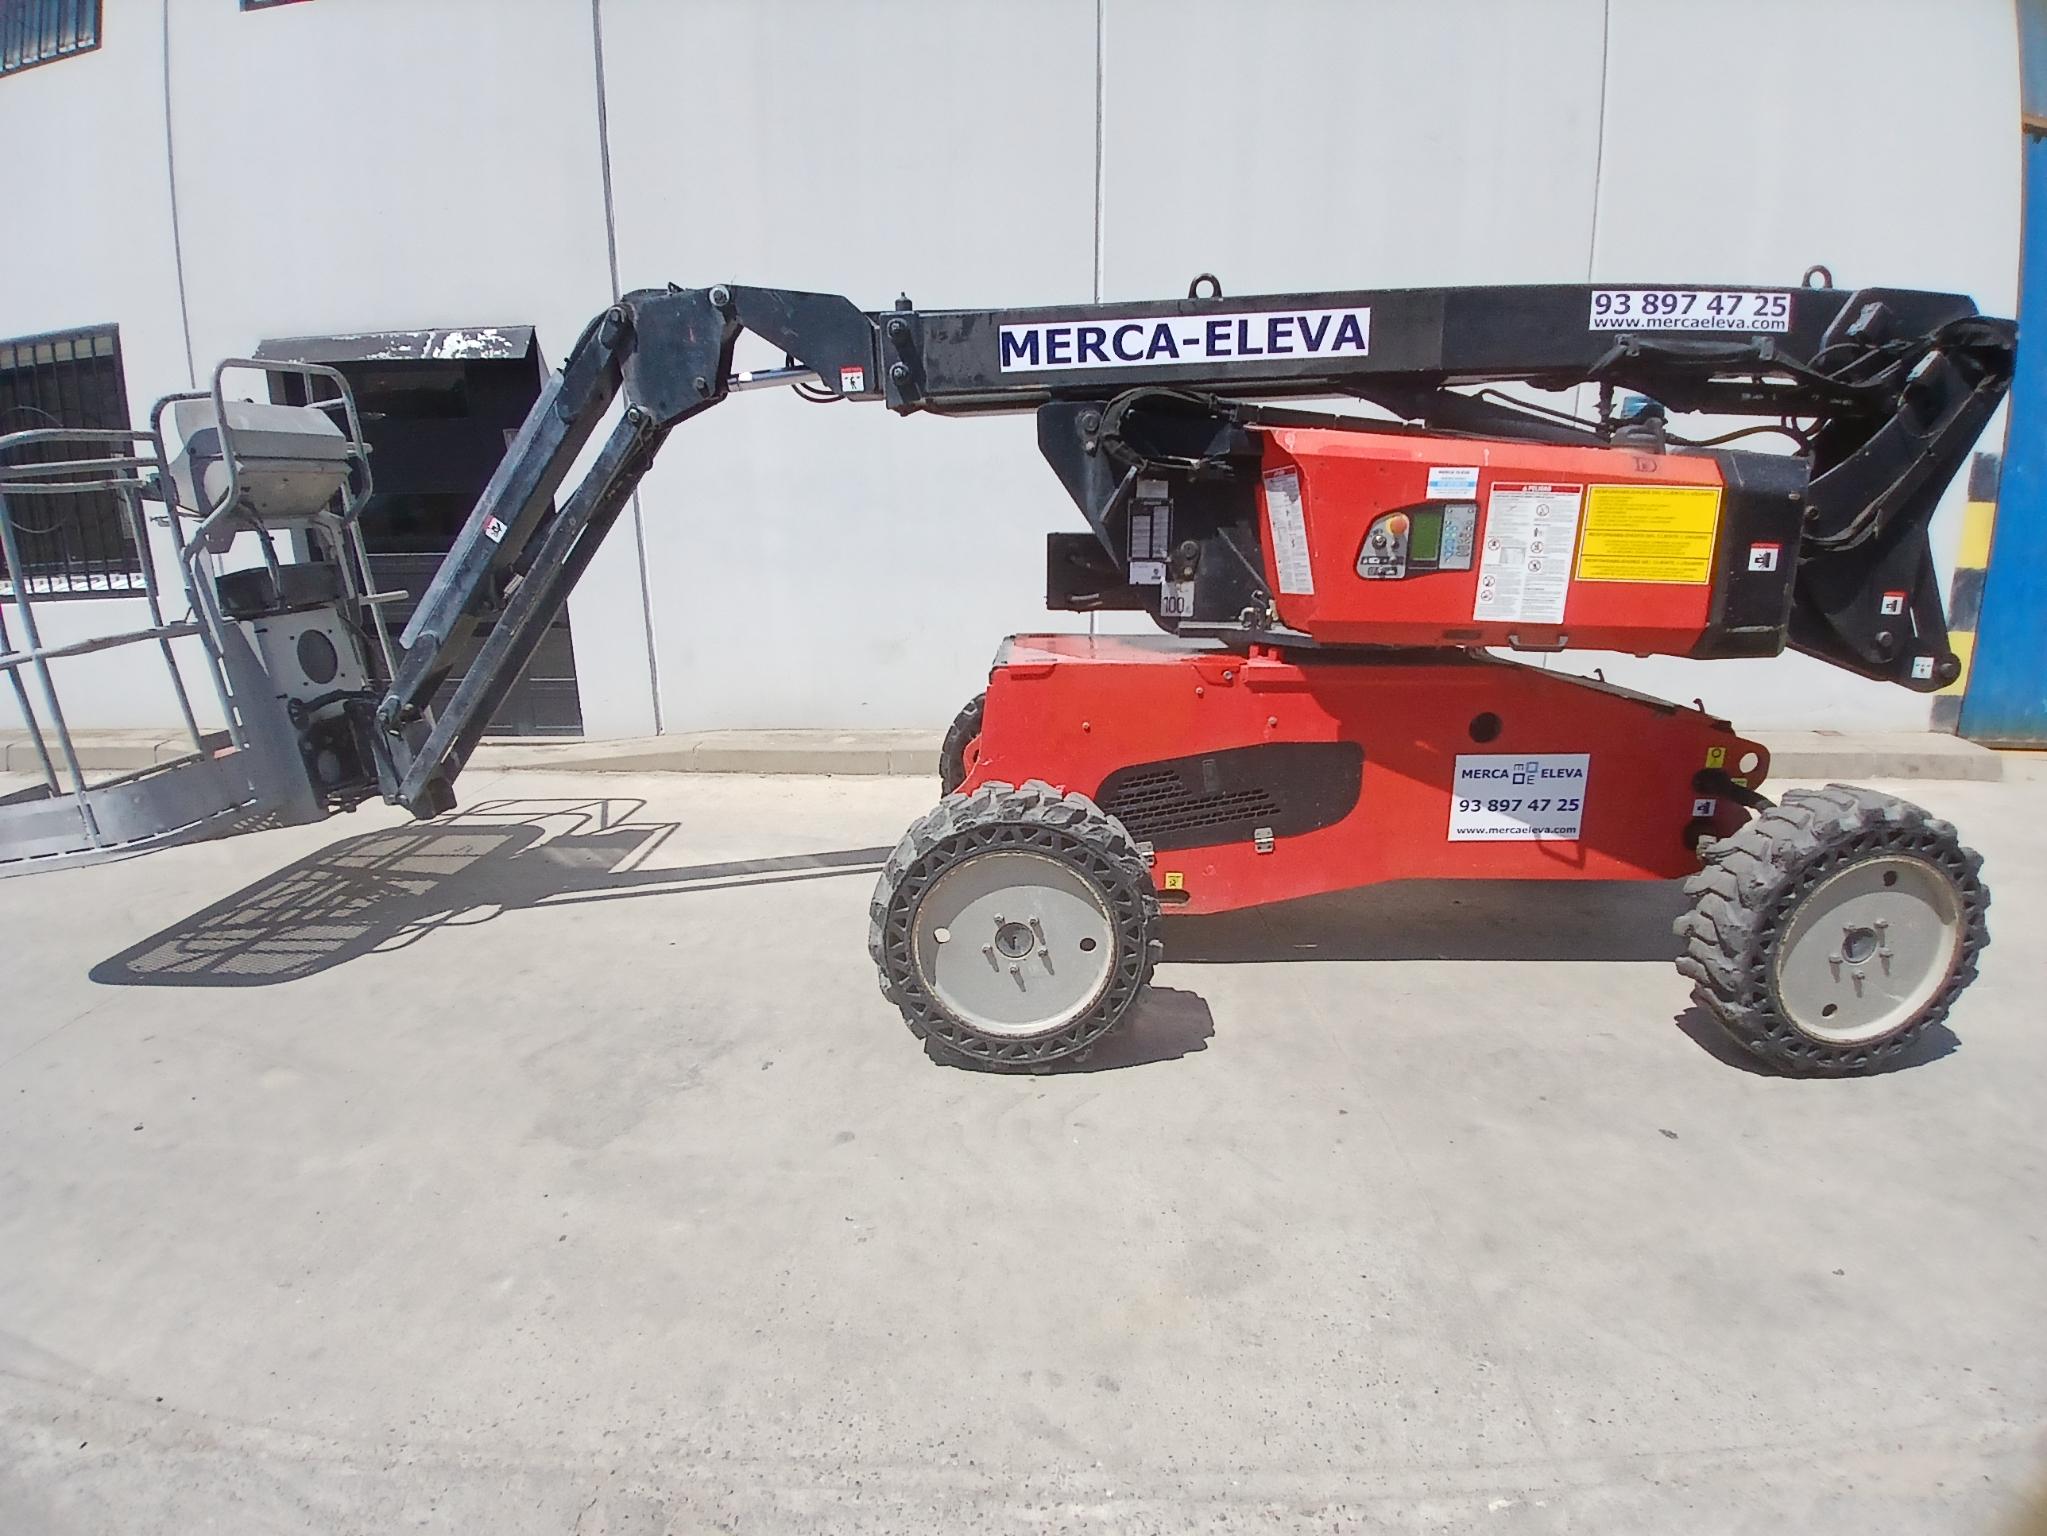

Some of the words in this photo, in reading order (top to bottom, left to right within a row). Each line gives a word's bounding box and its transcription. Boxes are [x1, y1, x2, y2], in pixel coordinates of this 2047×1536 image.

[1595, 294, 1631, 315] 93
[1641, 294, 1697, 315] 897
[1706, 295, 1743, 316] 47
[1753, 295, 1787, 317] 25
[1594, 316, 1785, 329] www.mercaeleva.com
[1001, 314, 1366, 367] MERCA-ELEVA
[1164, 596, 1185, 613] 100
[1461, 769, 1509, 779] MERCA
[1541, 768, 1583, 778] ELEVA
[1459, 799, 1481, 812] 93
[1487, 799, 1522, 812] 897
[1528, 799, 1551, 811] 47
[1556, 798, 1579, 811] 25
[1456, 826, 1576, 834] www.mercaeleva.com
